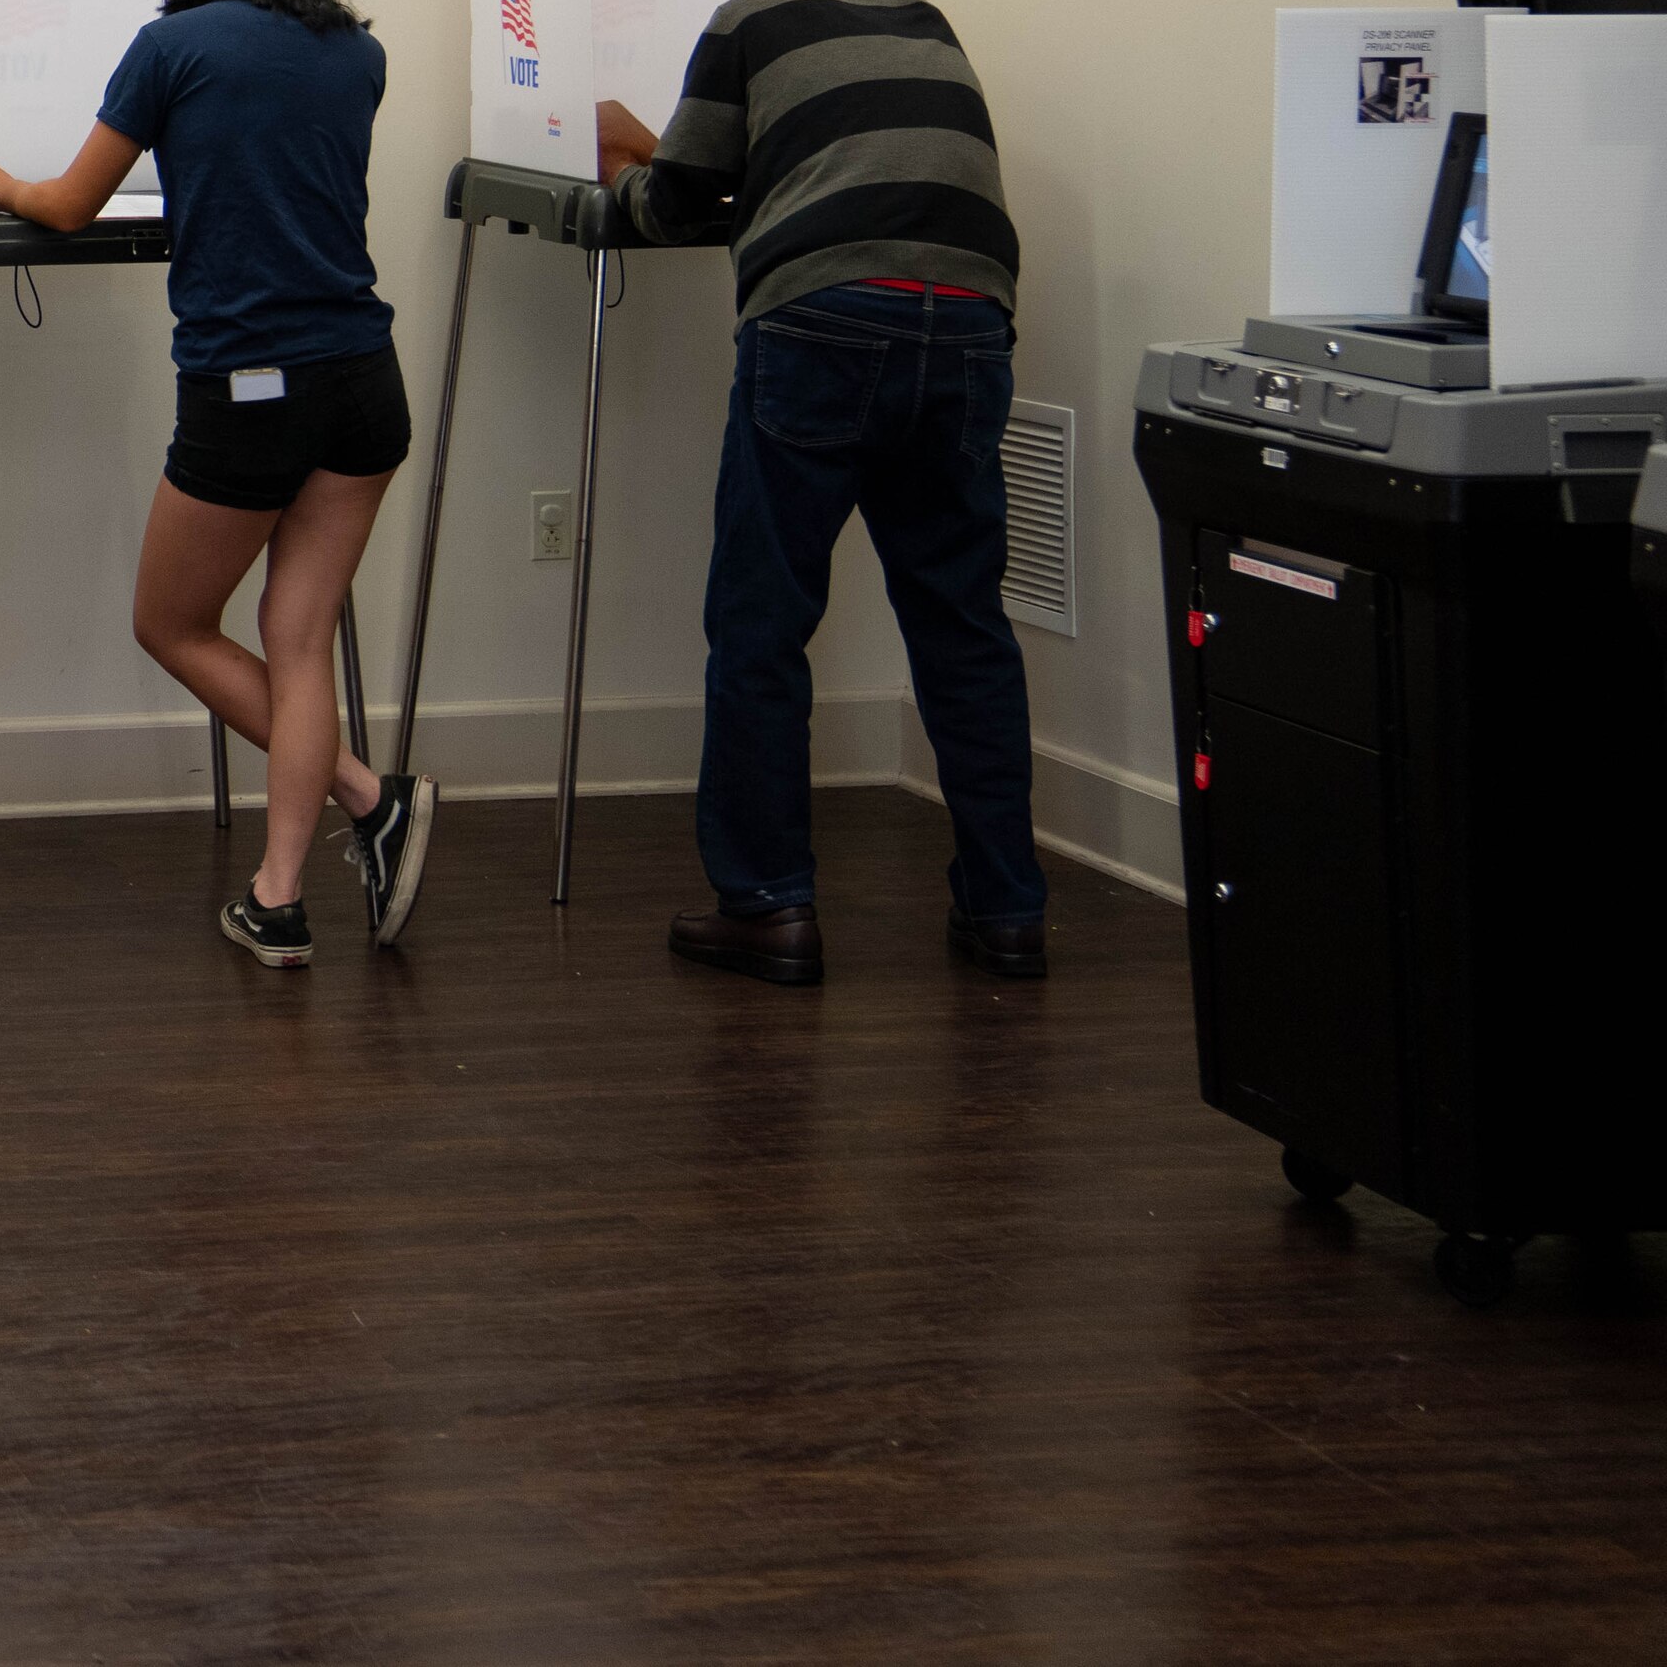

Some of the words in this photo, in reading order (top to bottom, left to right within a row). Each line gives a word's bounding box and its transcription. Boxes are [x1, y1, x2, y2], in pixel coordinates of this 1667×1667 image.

[1394, 30, 1436, 39] SCANNER
[1365, 43, 1402, 51] PRIVACY
[1404, 43, 1431, 51] PANEL
[510, 56, 539, 88] VOTE
